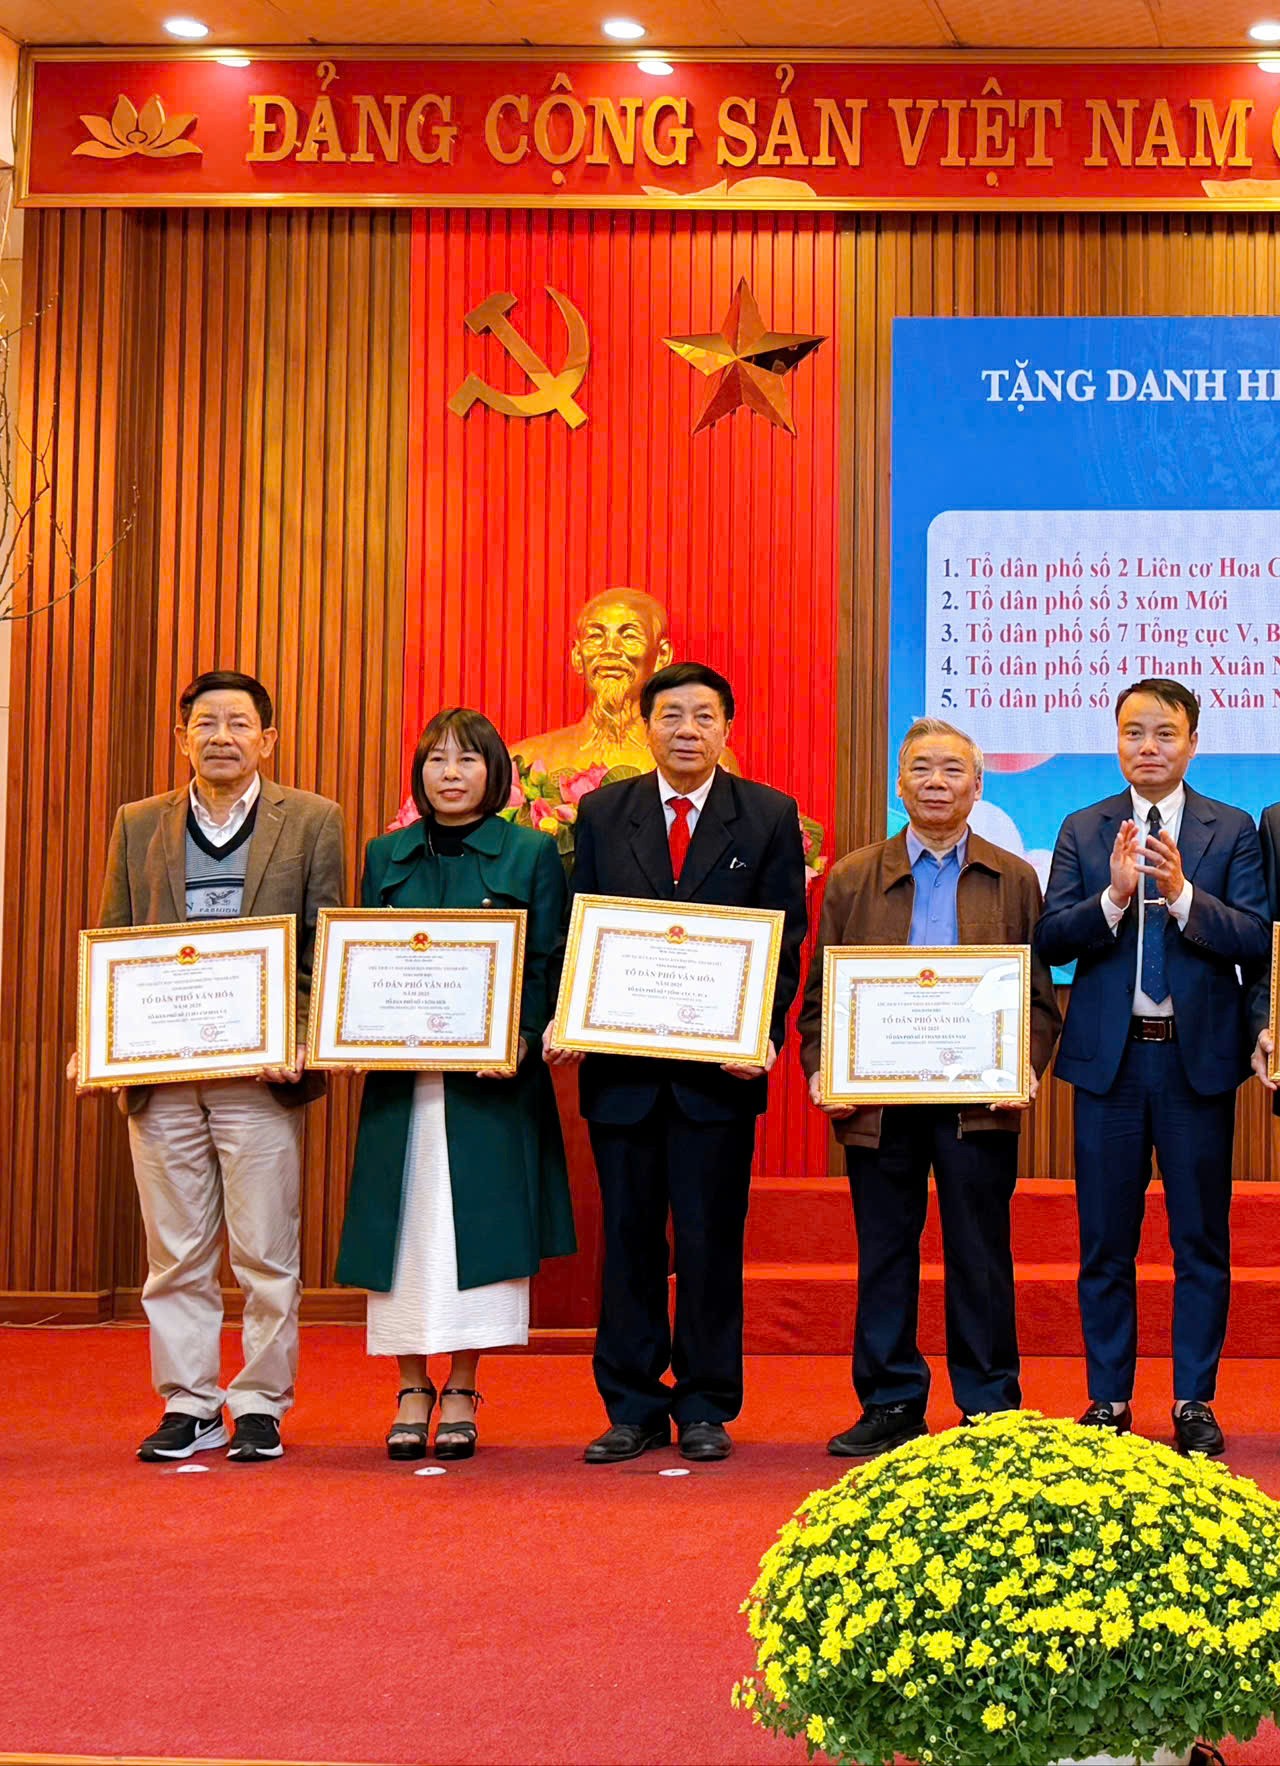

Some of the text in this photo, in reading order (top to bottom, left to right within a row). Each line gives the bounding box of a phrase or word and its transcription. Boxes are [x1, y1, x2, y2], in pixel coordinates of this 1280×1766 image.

[246, 61, 457, 164] ĐẢNG
[485, 72, 693, 185] CỘNG
[717, 64, 868, 166] SẢN
[888, 77, 1063, 187] VIỆT
[1084, 98, 1254, 168] NAM
[981, 359, 1096, 411] TẶNG
[1106, 368, 1228, 401] DANH
[943, 558, 959, 577] 1.
[966, 552, 993, 577] Tổ
[1000, 558, 1038, 577] dân
[1045, 552, 1083, 582] phố
[1090, 552, 1110, 577] số
[1118, 558, 1128, 577] 2
[1137, 558, 1181, 577] Liên
[1189, 561, 1213, 577] cơ
[1219, 558, 1260, 577] Hoa
[942, 585, 1228, 615] 2. Tổ dân phố số 3 xóm Mới
[941, 624, 958, 643] 3.
[965, 617, 993, 643] Tổ
[1000, 623, 1038, 643] dân
[1045, 617, 1083, 648] phố
[1090, 617, 1110, 643] số
[1117, 624, 1128, 642] 7
[1136, 617, 1189, 647] Tổng
[1195, 628, 1229, 647] cục
[1237, 624, 1259, 644] V,
[941, 656, 958, 675] 4.
[965, 650, 992, 675] Tổ
[1000, 656, 1037, 675] dân
[1045, 650, 1082, 680] phố
[1089, 650, 1109, 675] số
[1117, 656, 1128, 675] 4
[1135, 656, 1201, 675] Thanh
[1210, 656, 1265, 675] Xuân
[941, 683, 1109, 713] 5. Tổ dân phố số
[1210, 688, 1265, 708] Xuân
